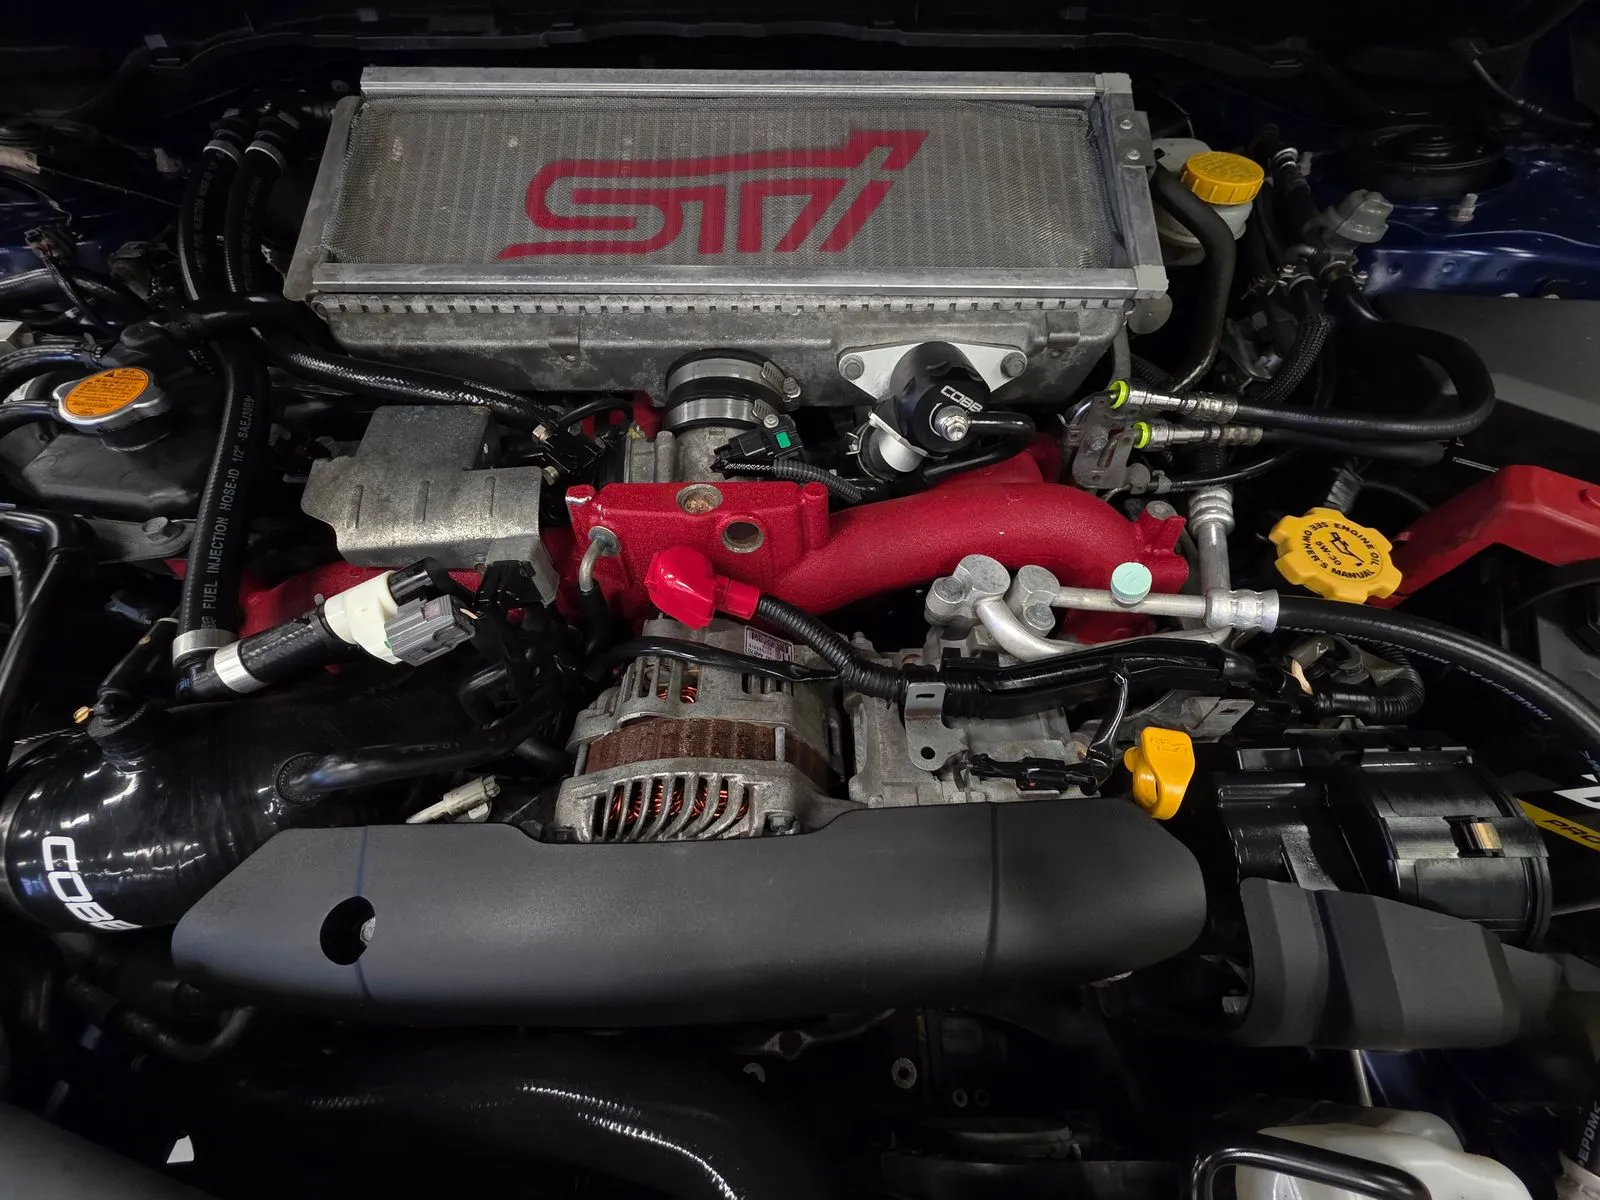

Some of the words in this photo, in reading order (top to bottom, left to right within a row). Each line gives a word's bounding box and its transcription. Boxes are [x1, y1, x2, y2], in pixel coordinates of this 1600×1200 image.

[940, 385, 984, 412] COBB
[1311, 521, 1329, 531] SEE
[206, 516, 229, 574] INJECTION
[1301, 530, 1329, 569] OWNER'S
[1315, 541, 1342, 566] 5W-30
[1333, 523, 1375, 550] ENGINE
[1370, 552, 1380, 565] OIL
[1331, 568, 1375, 579] MANUAL
[203, 580, 218, 609] FUEL
